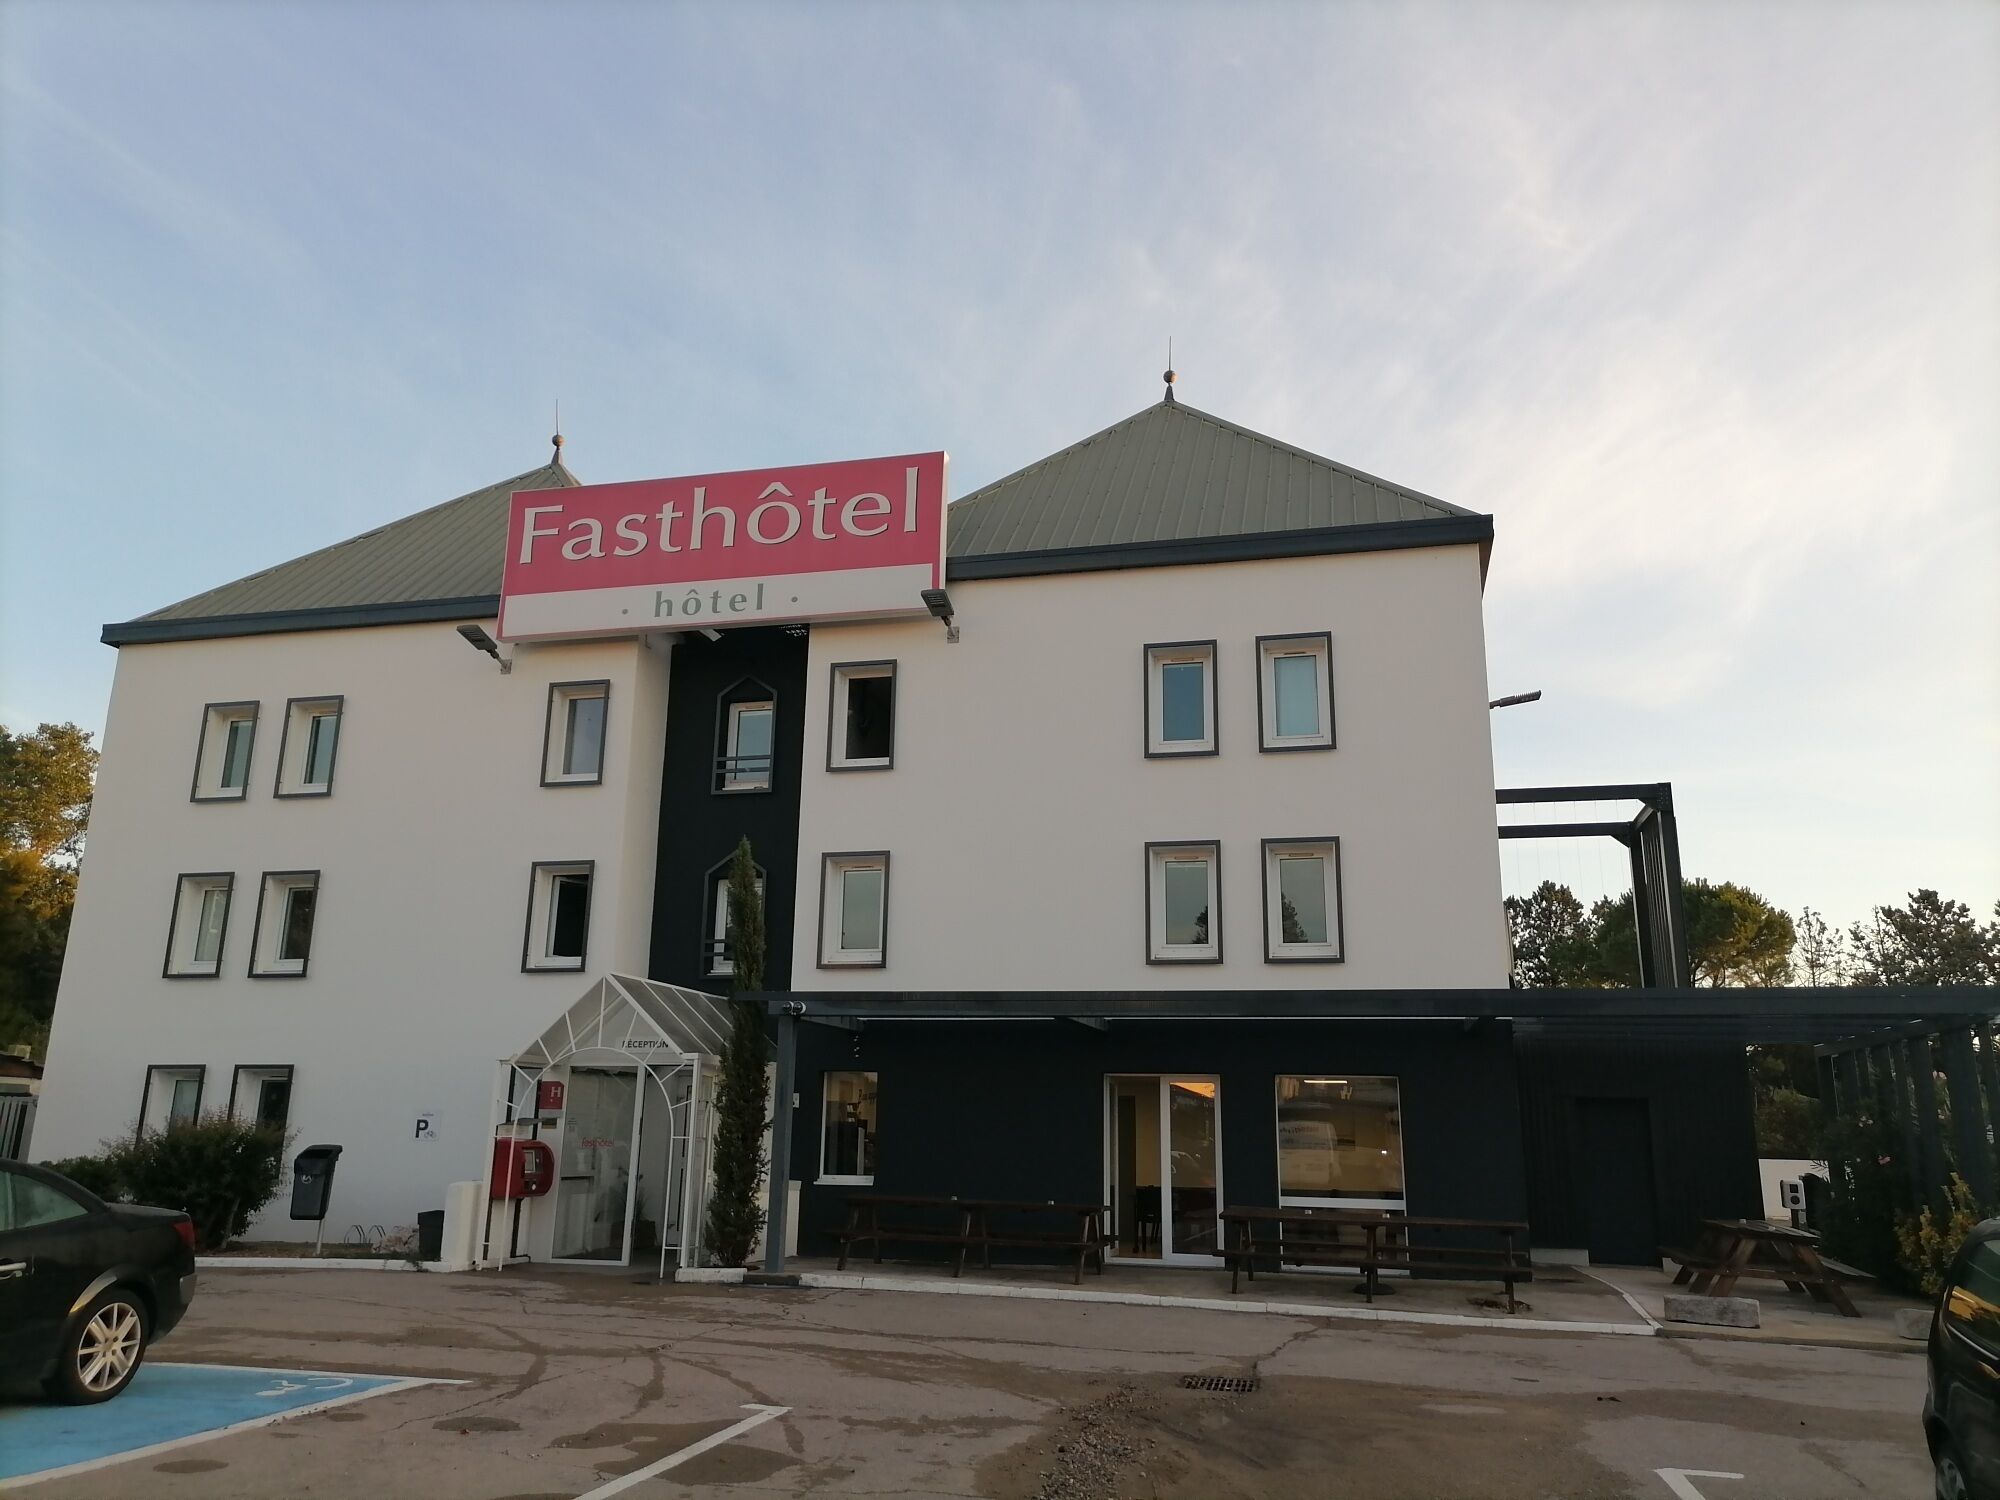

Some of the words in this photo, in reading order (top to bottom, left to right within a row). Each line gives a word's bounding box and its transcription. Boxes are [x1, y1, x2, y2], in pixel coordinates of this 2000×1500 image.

[519, 466, 919, 564] Fasthôtel
[654, 583, 764, 618] hôtel
[550, 1086, 562, 1098] H
[416, 1119, 430, 1139] P
